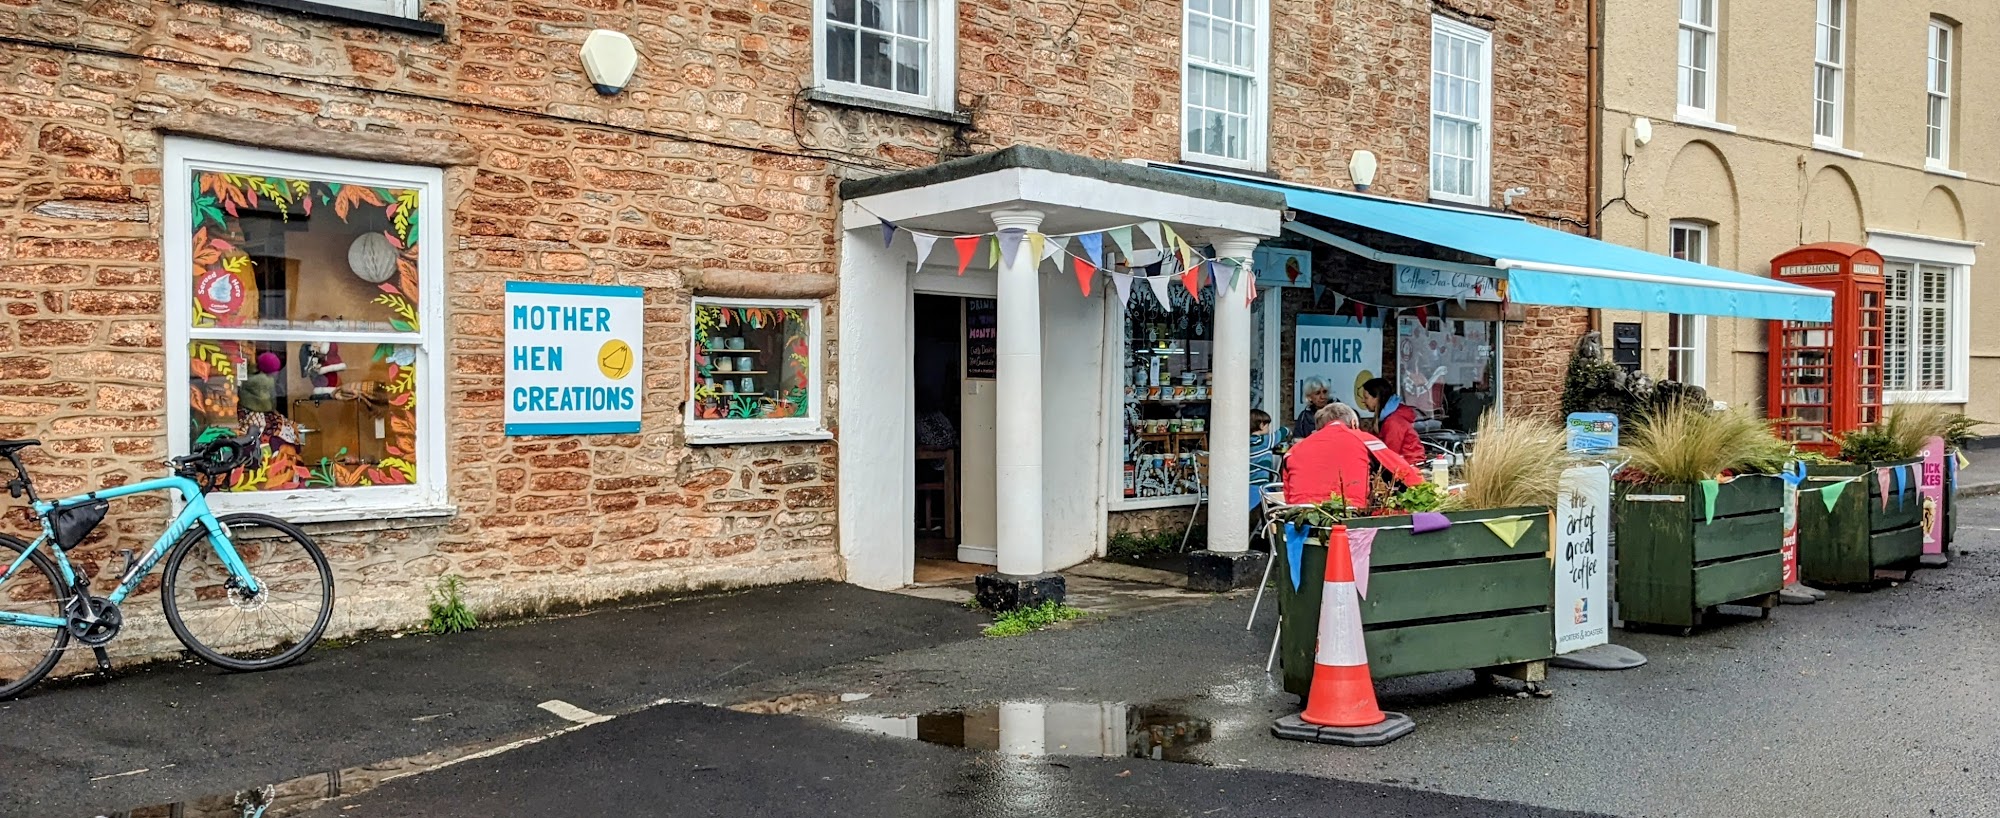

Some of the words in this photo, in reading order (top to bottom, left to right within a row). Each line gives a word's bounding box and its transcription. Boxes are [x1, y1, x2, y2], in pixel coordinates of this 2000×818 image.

[1784, 264, 1837, 274] TELEPHONE
[198, 271, 217, 295] Served
[231, 278, 241, 298] Here
[513, 305, 611, 332] MOTHER
[969, 327, 996, 339] MONTH
[513, 346, 563, 371] HEN
[1300, 338, 1363, 364] MOTHER
[513, 386, 635, 412] CREATIONS
[1569, 488, 1587, 509] the
[1566, 508, 1583, 536] art
[1566, 531, 1597, 574] great
[1572, 556, 1598, 590] coffee
